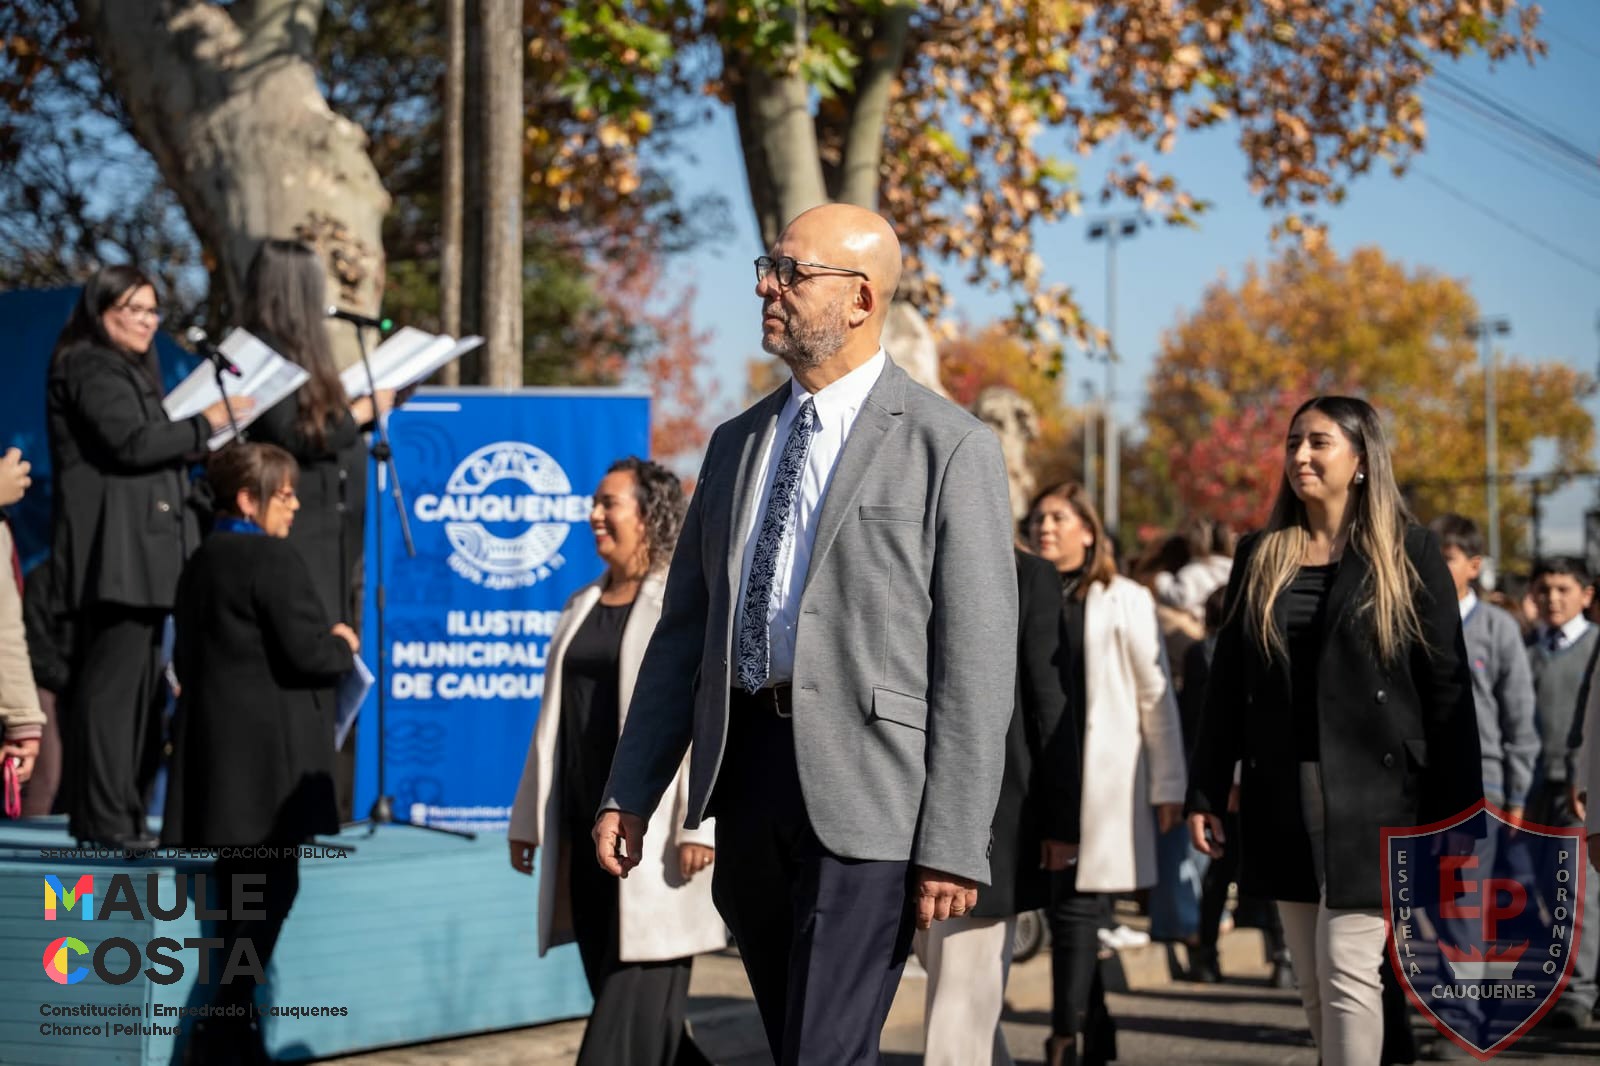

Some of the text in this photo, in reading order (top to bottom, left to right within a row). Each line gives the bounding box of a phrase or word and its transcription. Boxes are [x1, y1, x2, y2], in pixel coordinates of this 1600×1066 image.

[414, 494, 593, 522] CAUQUENES
[447, 610, 560, 636] ILUSTRE
[392, 673, 433, 699] DE
